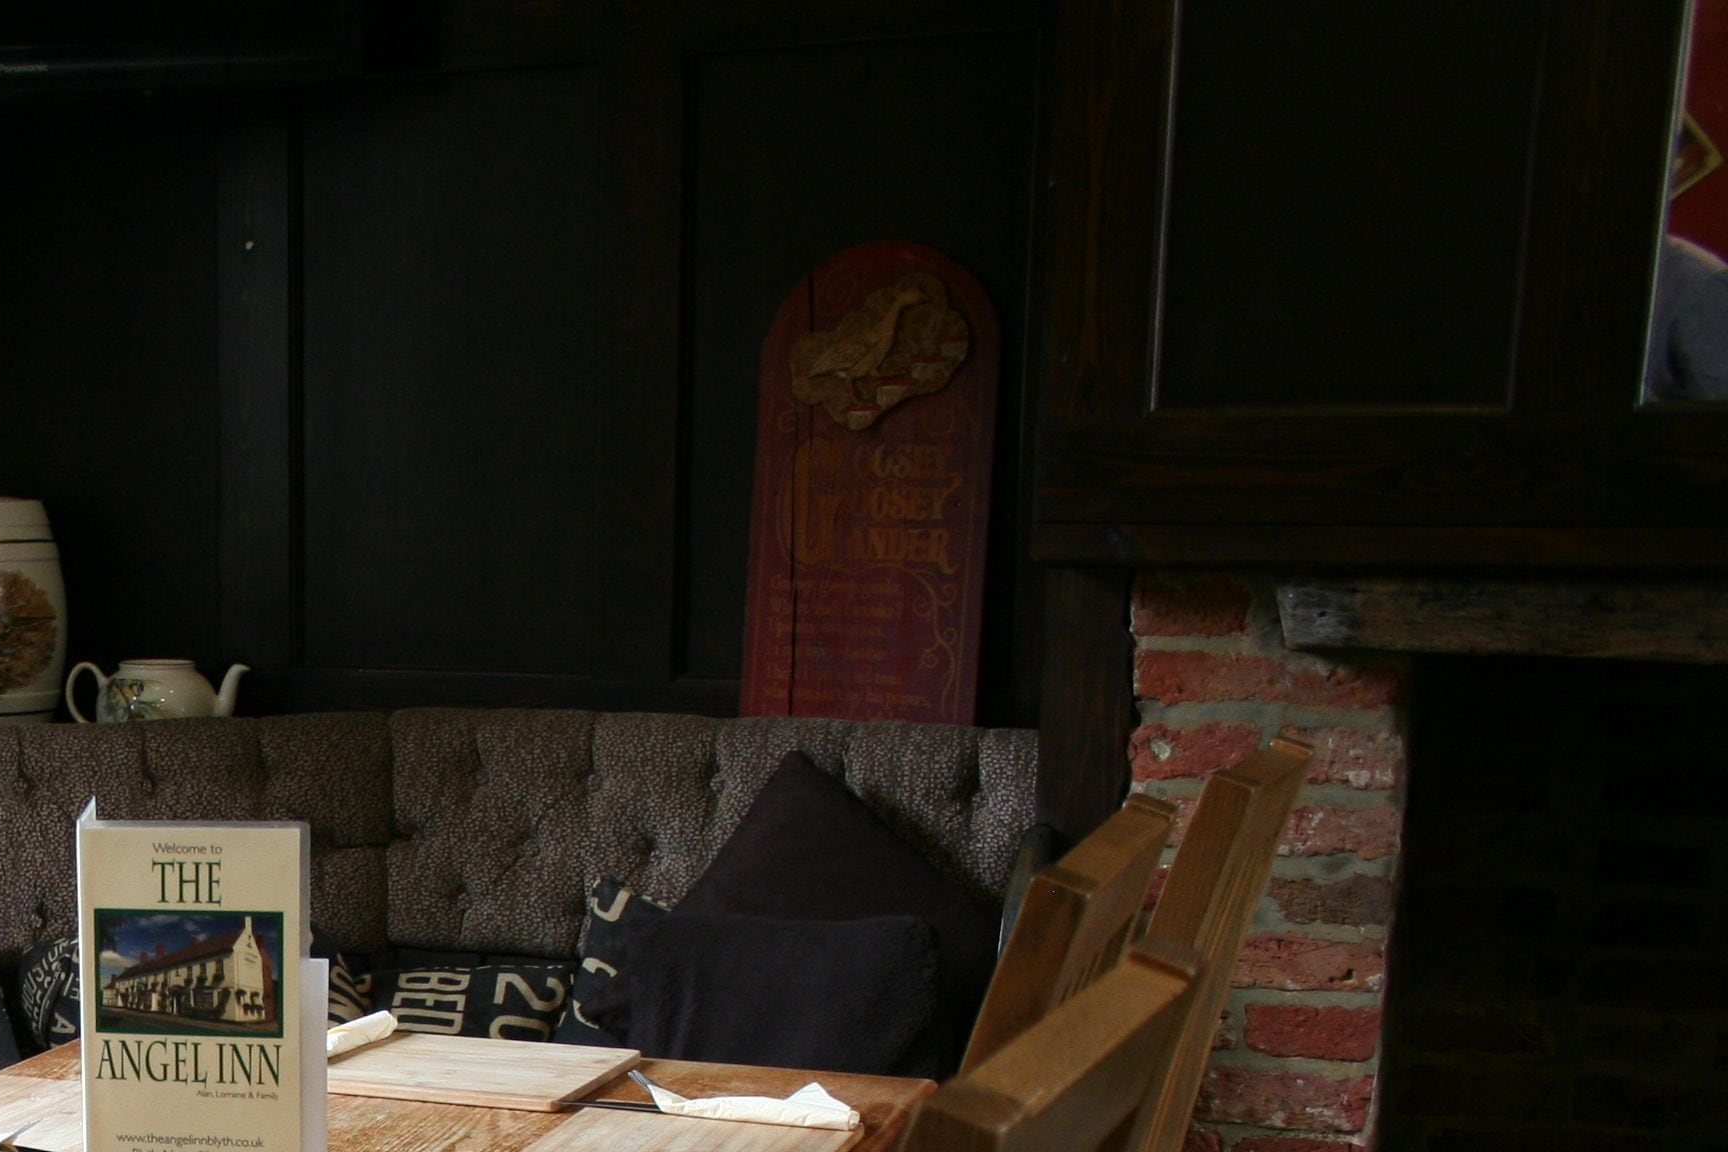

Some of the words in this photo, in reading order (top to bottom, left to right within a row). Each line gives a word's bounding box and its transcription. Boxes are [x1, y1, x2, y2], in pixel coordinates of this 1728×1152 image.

[152, 842, 207, 855] Welcome
[210, 844, 222, 855] to
[151, 857, 222, 907] THE
[96, 1038, 209, 1089] ANGEL
[217, 1043, 282, 1087] INN
[215, 1090, 246, 1099] Lorraine
[256, 1092, 279, 1101] Family
[116, 1132, 265, 1148] www.theangelinnblyth.co.uk
